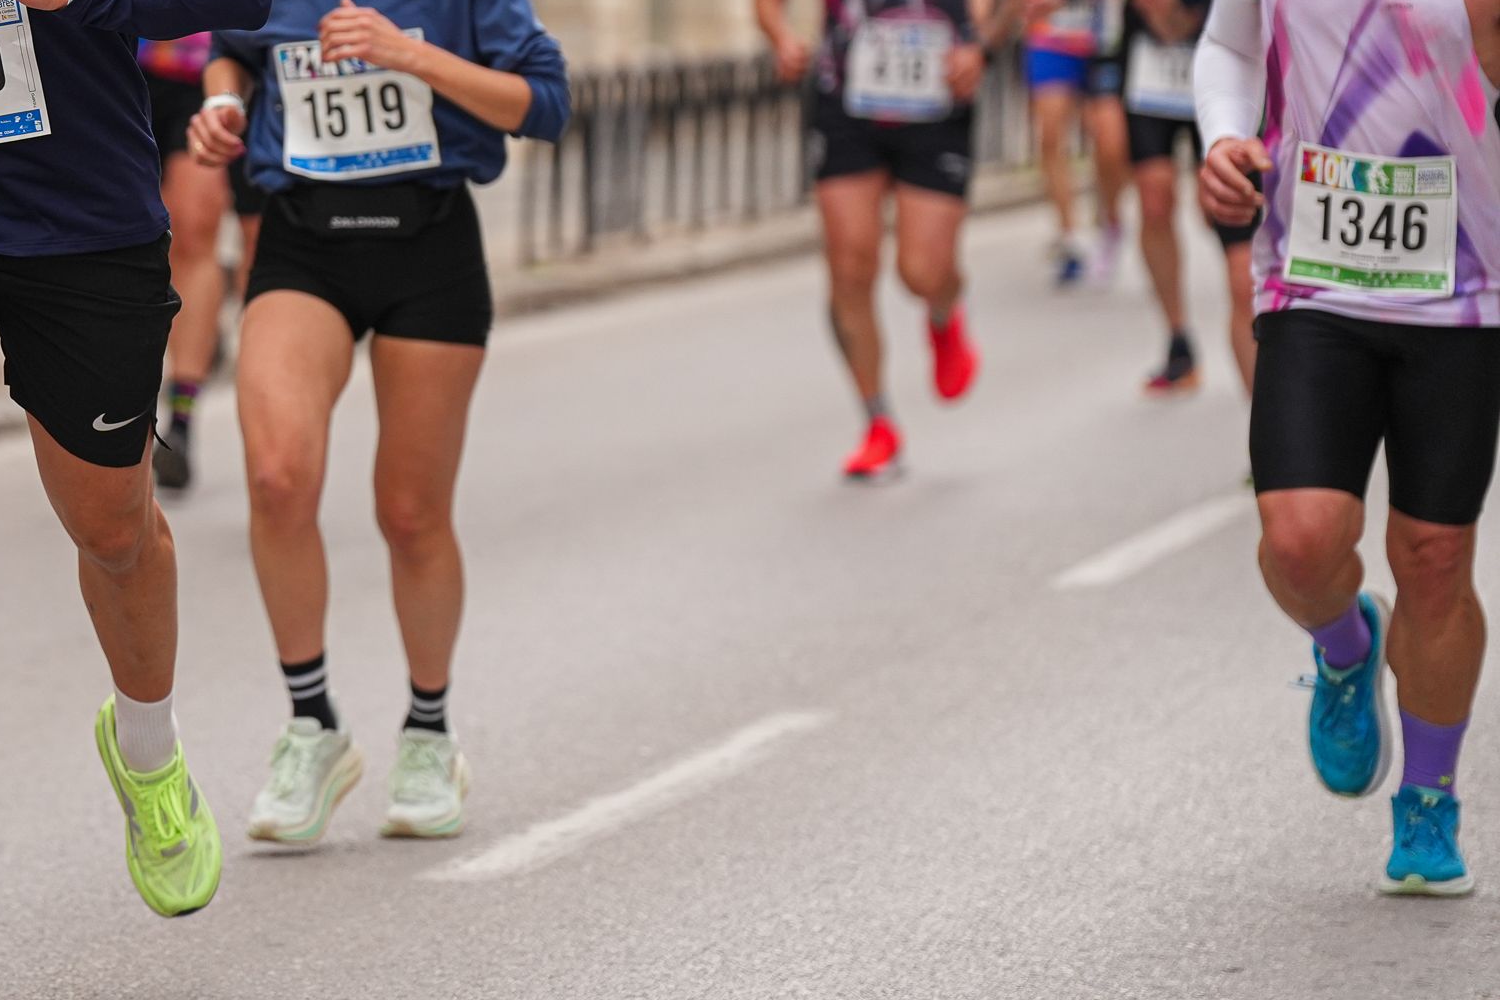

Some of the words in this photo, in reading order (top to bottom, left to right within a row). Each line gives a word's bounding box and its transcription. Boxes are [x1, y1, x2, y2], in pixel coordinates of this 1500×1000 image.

[305, 82, 405, 139] 1519
[1313, 152, 1355, 190] 10K
[1317, 193, 1428, 251] 1346
